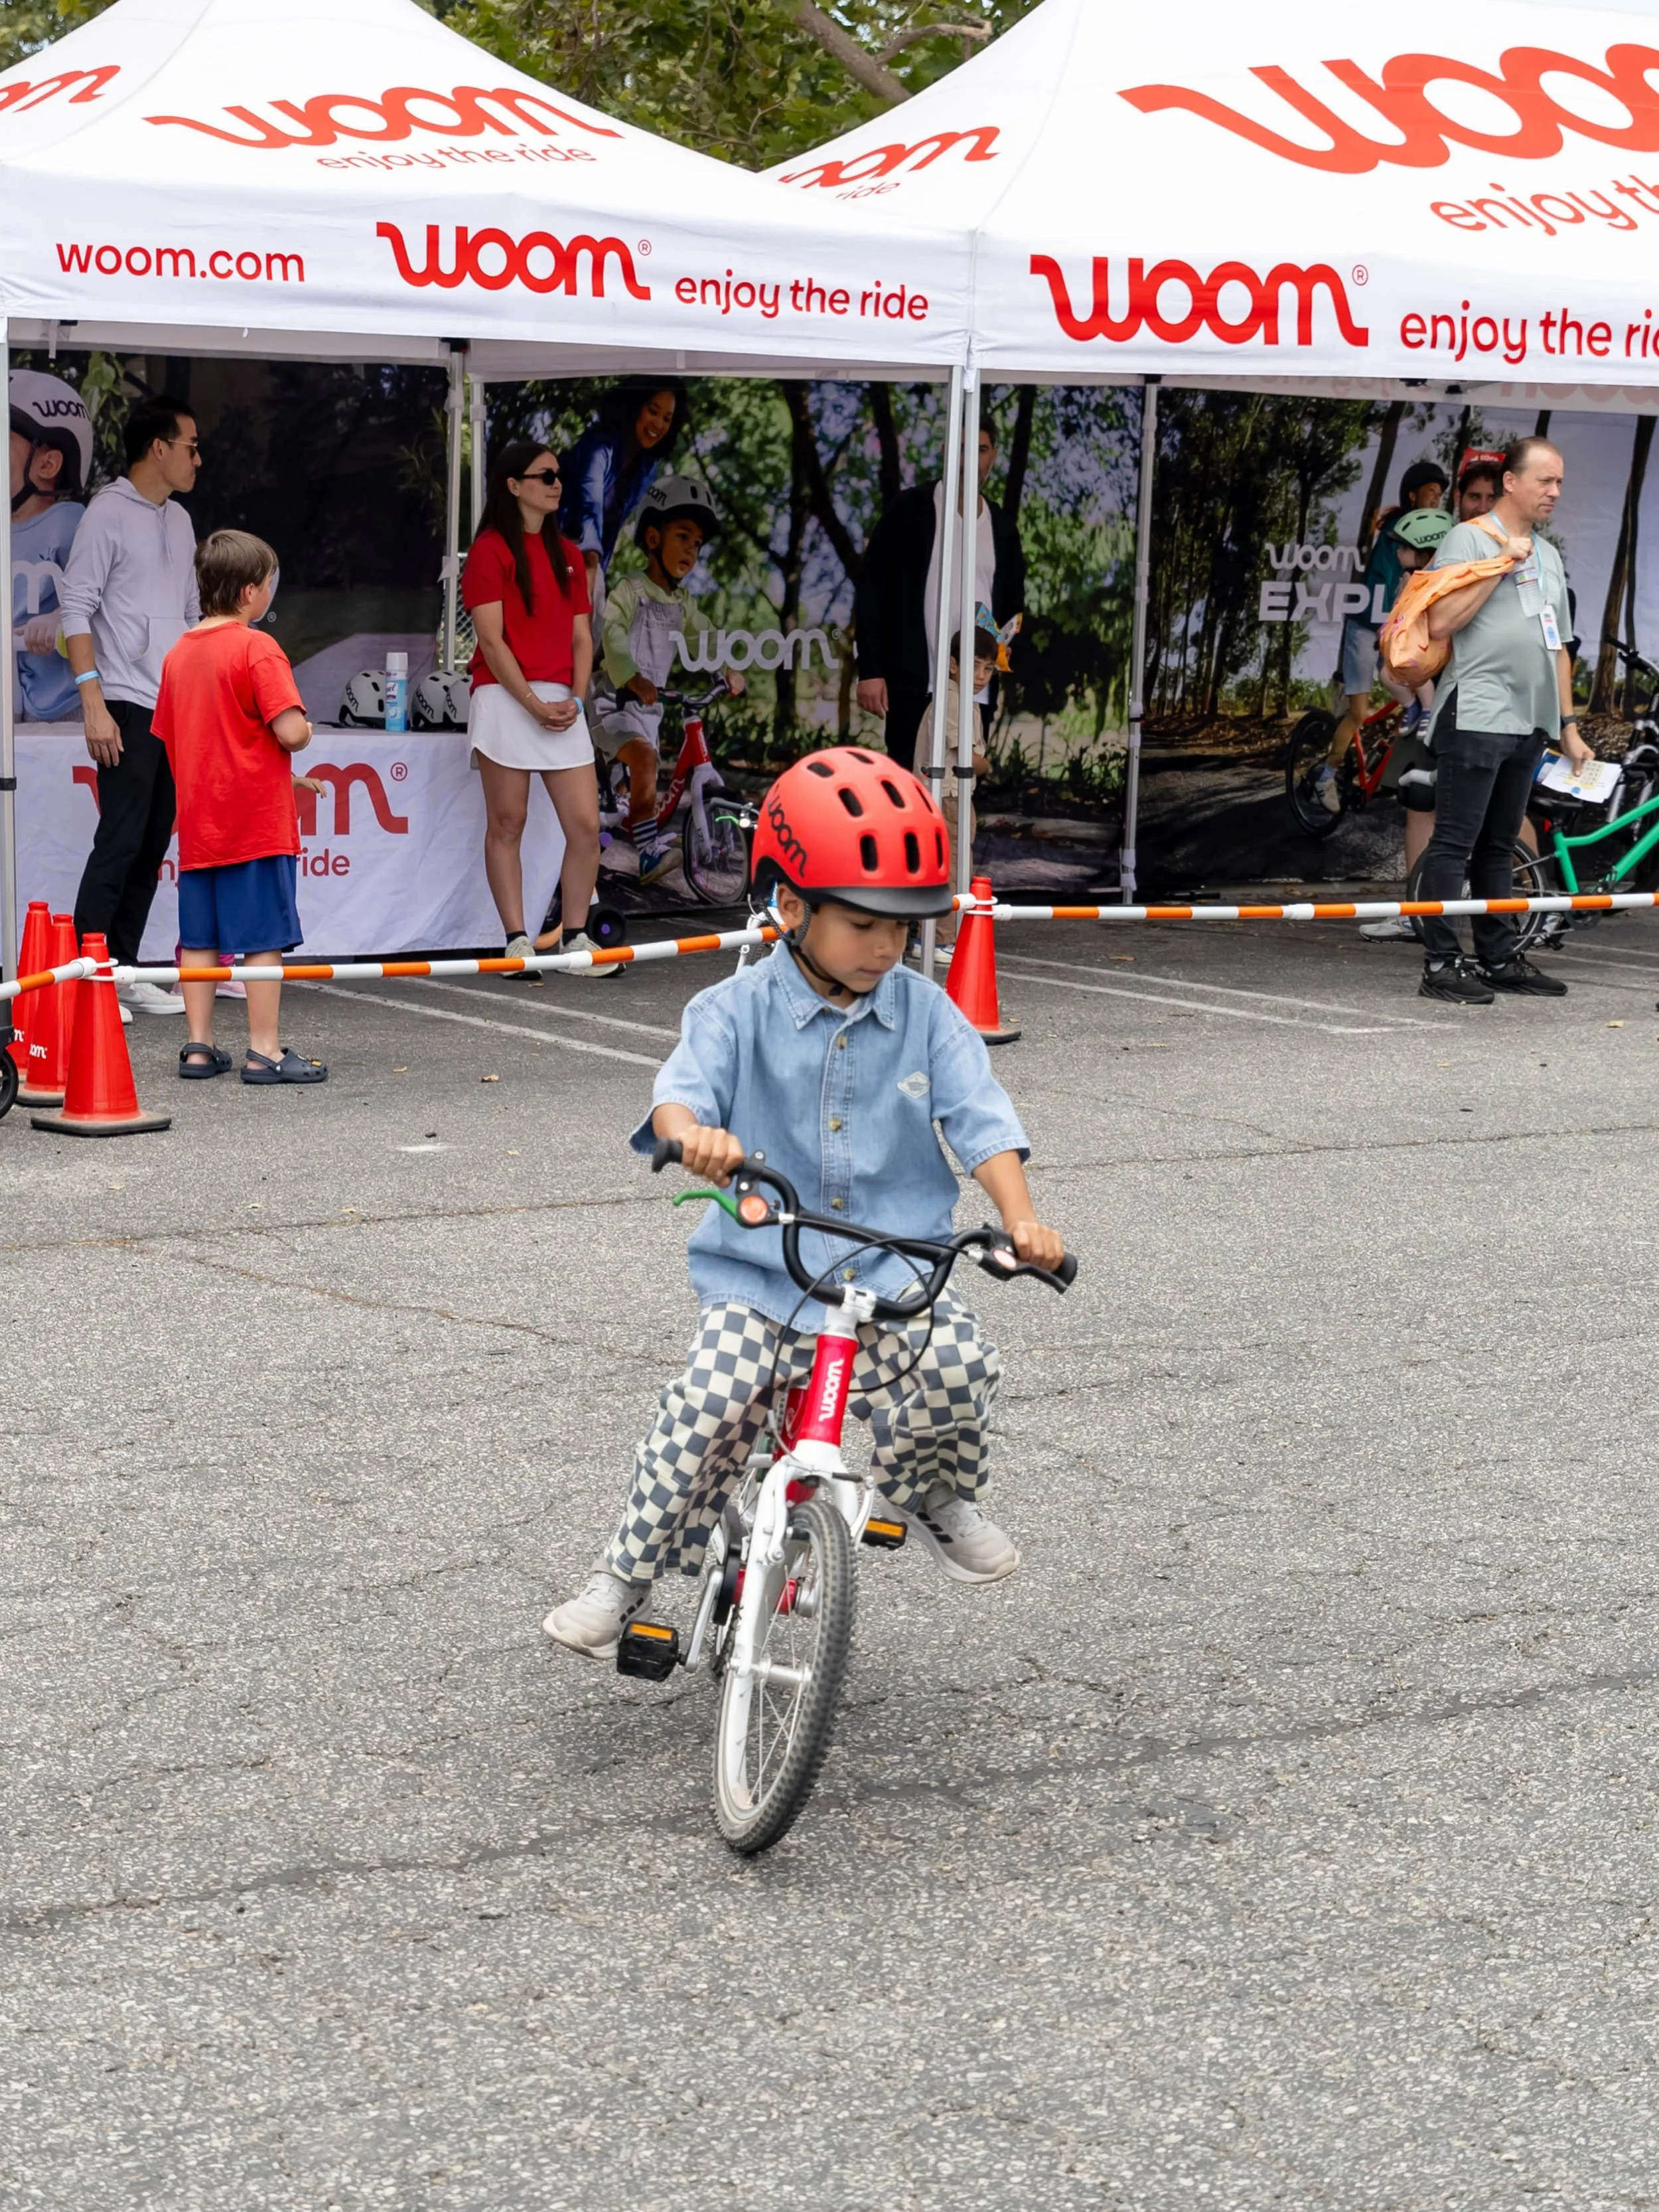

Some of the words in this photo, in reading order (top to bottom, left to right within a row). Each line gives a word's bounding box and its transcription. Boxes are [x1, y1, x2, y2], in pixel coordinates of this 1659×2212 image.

[142, 86, 625, 149] woom
[1116, 42, 1659, 175] woo
[317, 151, 447, 171] enjoy
[436, 146, 516, 163] the
[514, 143, 597, 162] ride
[1429, 182, 1639, 236] enjoy
[56, 243, 305, 283] woom.com
[674, 268, 781, 319] enjoy
[789, 277, 851, 315] the
[859, 279, 930, 321] ride
[1399, 299, 1529, 366] enjoy
[1538, 307, 1613, 358] the
[766, 782, 808, 878] woom
[818, 1358, 845, 1422] woom
